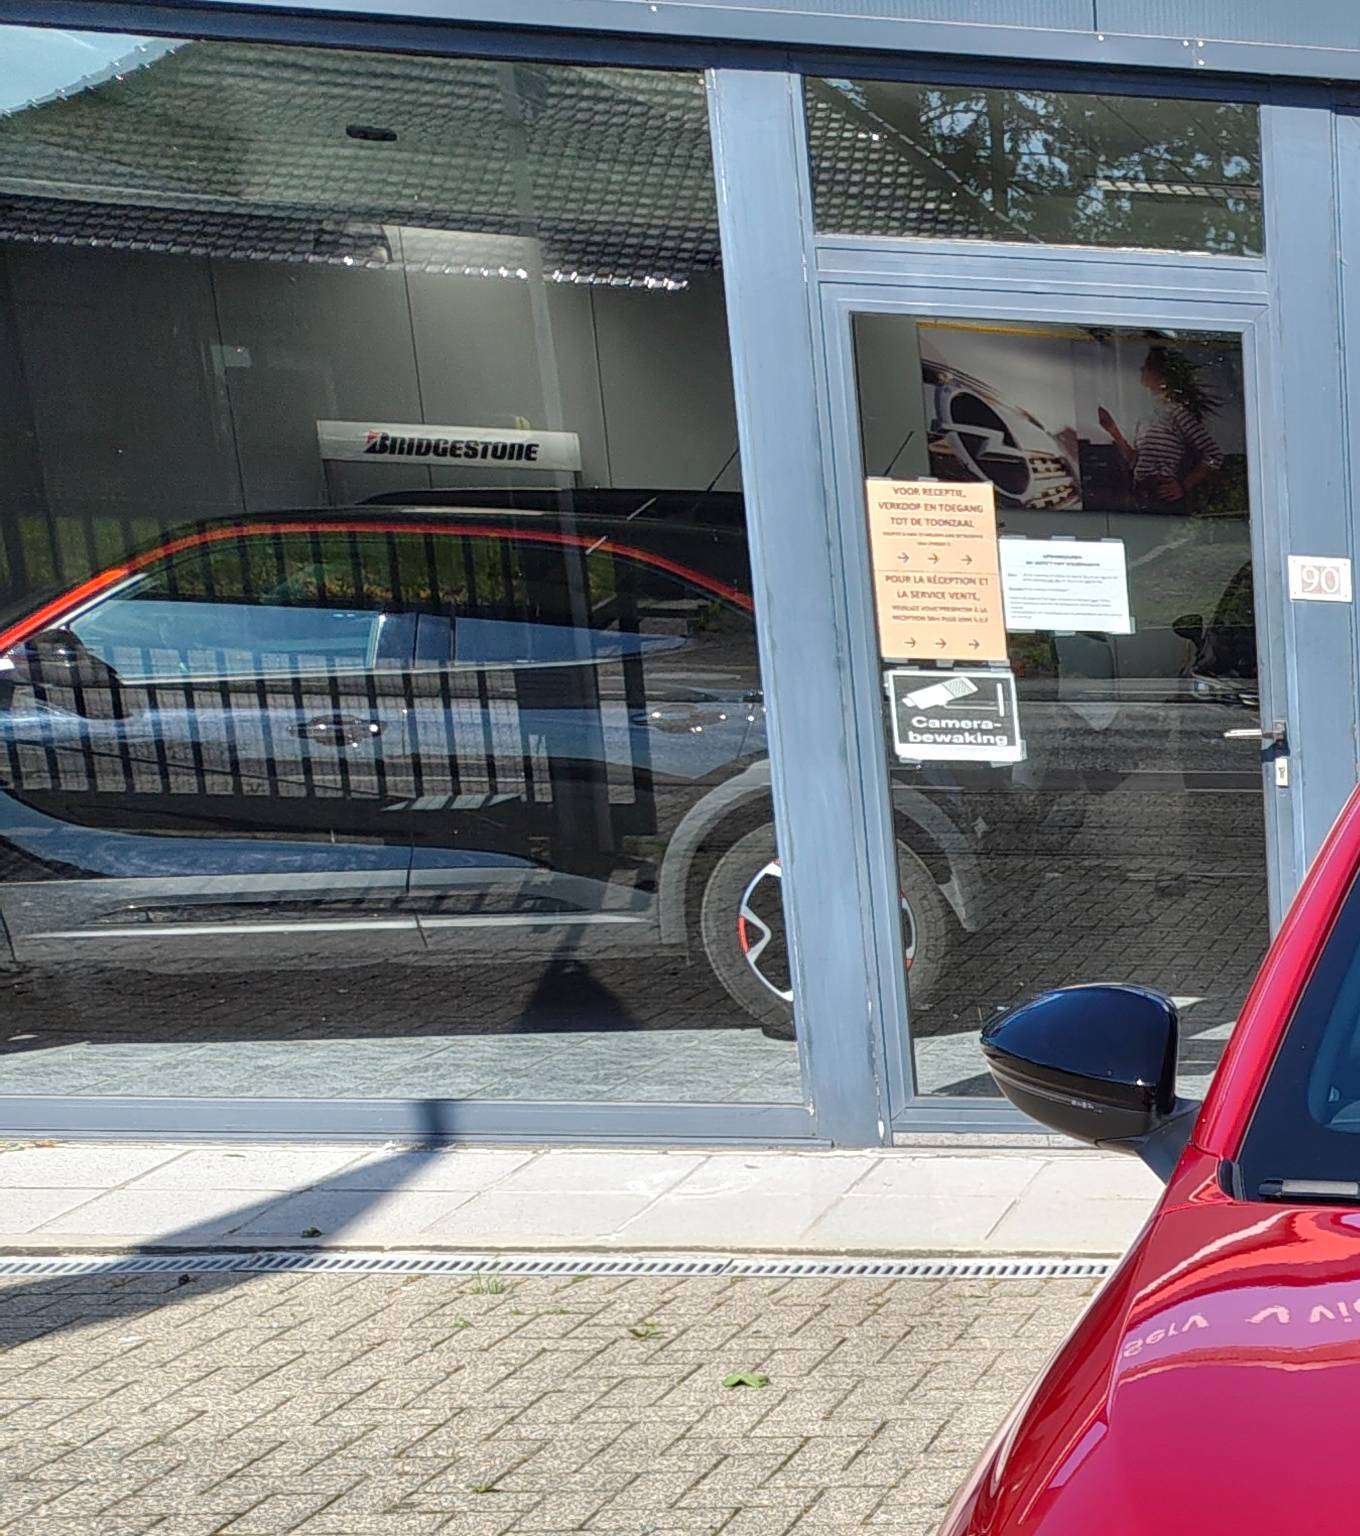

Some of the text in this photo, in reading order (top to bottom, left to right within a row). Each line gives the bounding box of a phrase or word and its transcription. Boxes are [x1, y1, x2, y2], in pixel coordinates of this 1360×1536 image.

[364, 430, 539, 462] BRIDGESTONE
[893, 487, 919, 496] VOOR
[924, 504, 936, 512] EN
[939, 504, 984, 513] TOEGANG
[890, 517, 908, 526] TOT
[911, 518, 923, 527] DE
[914, 576, 925, 584] LA
[1303, 565, 1340, 593] 90
[897, 591, 908, 599] LA
[911, 716, 1002, 730] Camera-
[908, 731, 1008, 747] bewaking
